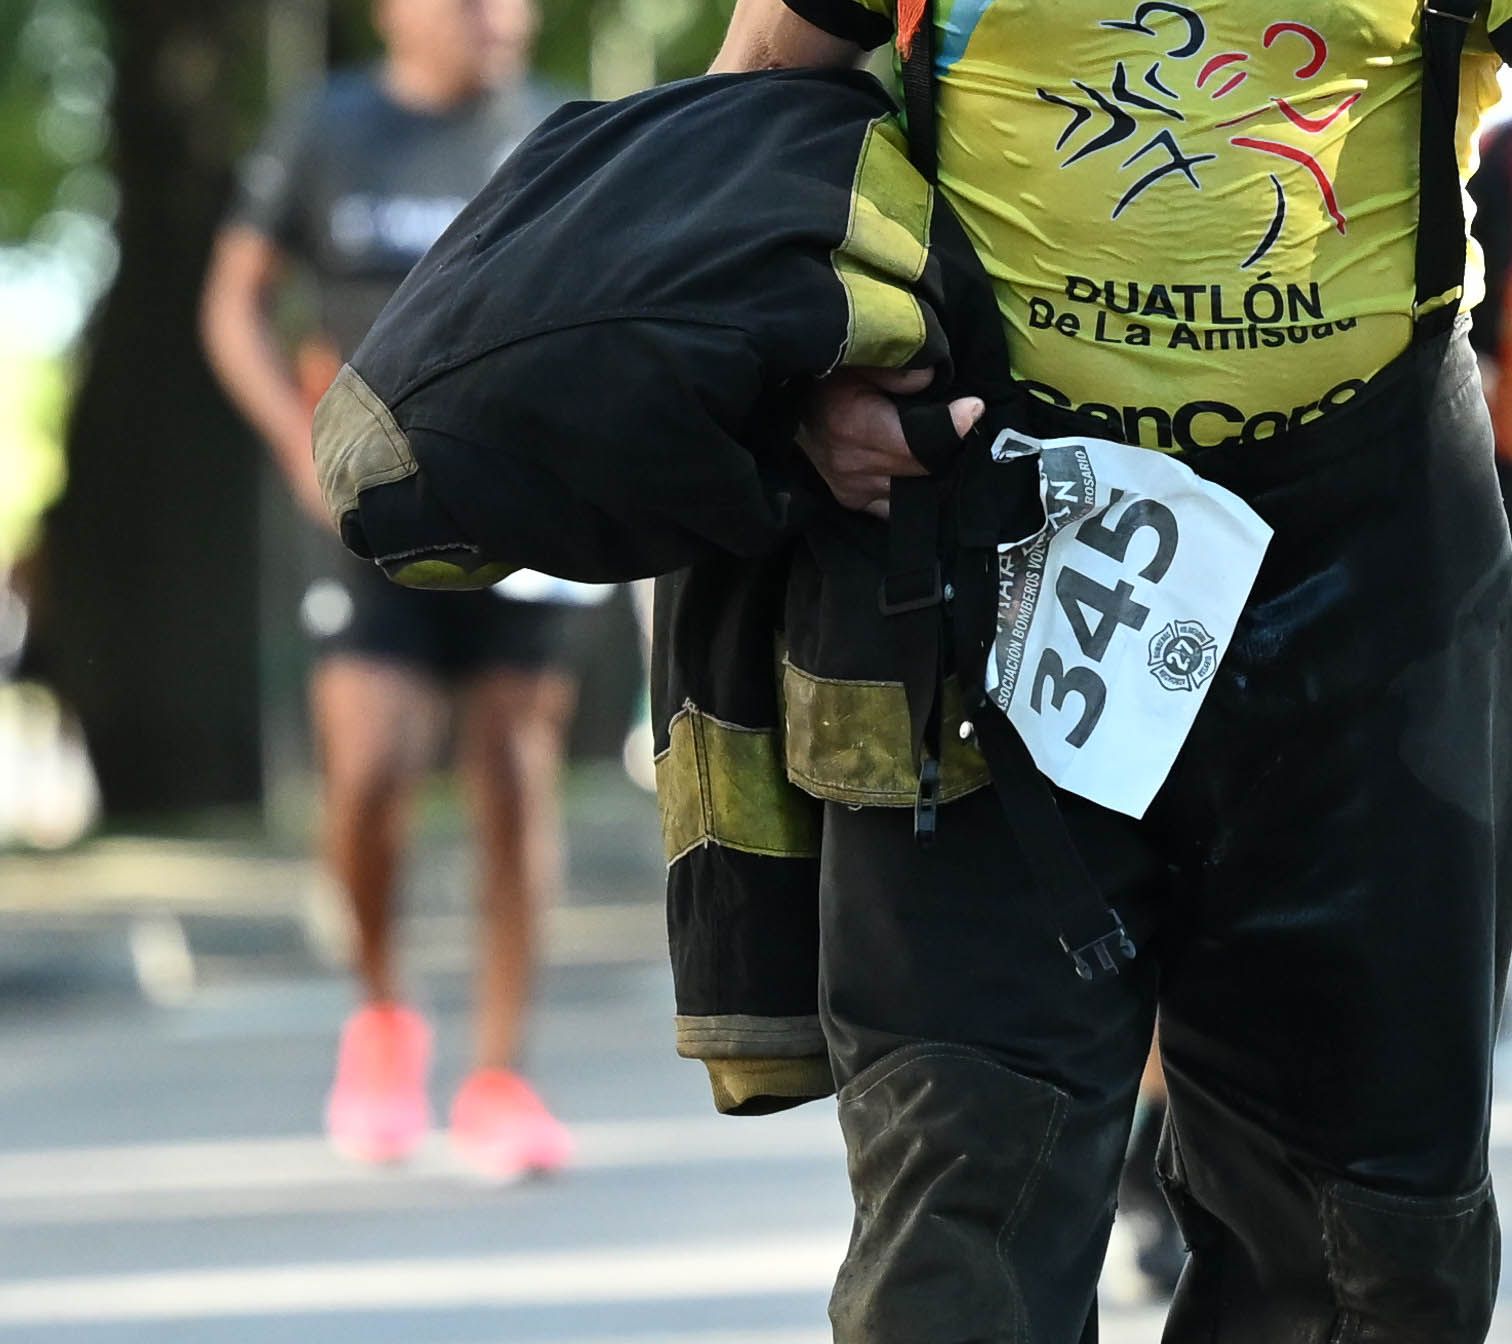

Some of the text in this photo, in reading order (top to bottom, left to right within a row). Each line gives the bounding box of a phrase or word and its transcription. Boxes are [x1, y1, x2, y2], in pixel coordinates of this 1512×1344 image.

[1029, 297, 1081, 337] De
[1095, 311, 1152, 346] La
[1065, 271, 1325, 325] DUATLÓN
[1076, 450, 1096, 505] ROSARIO
[1010, 572, 1041, 639] BOMBEROS
[1030, 489, 1178, 749] 345
[1166, 639, 1194, 672] 27
